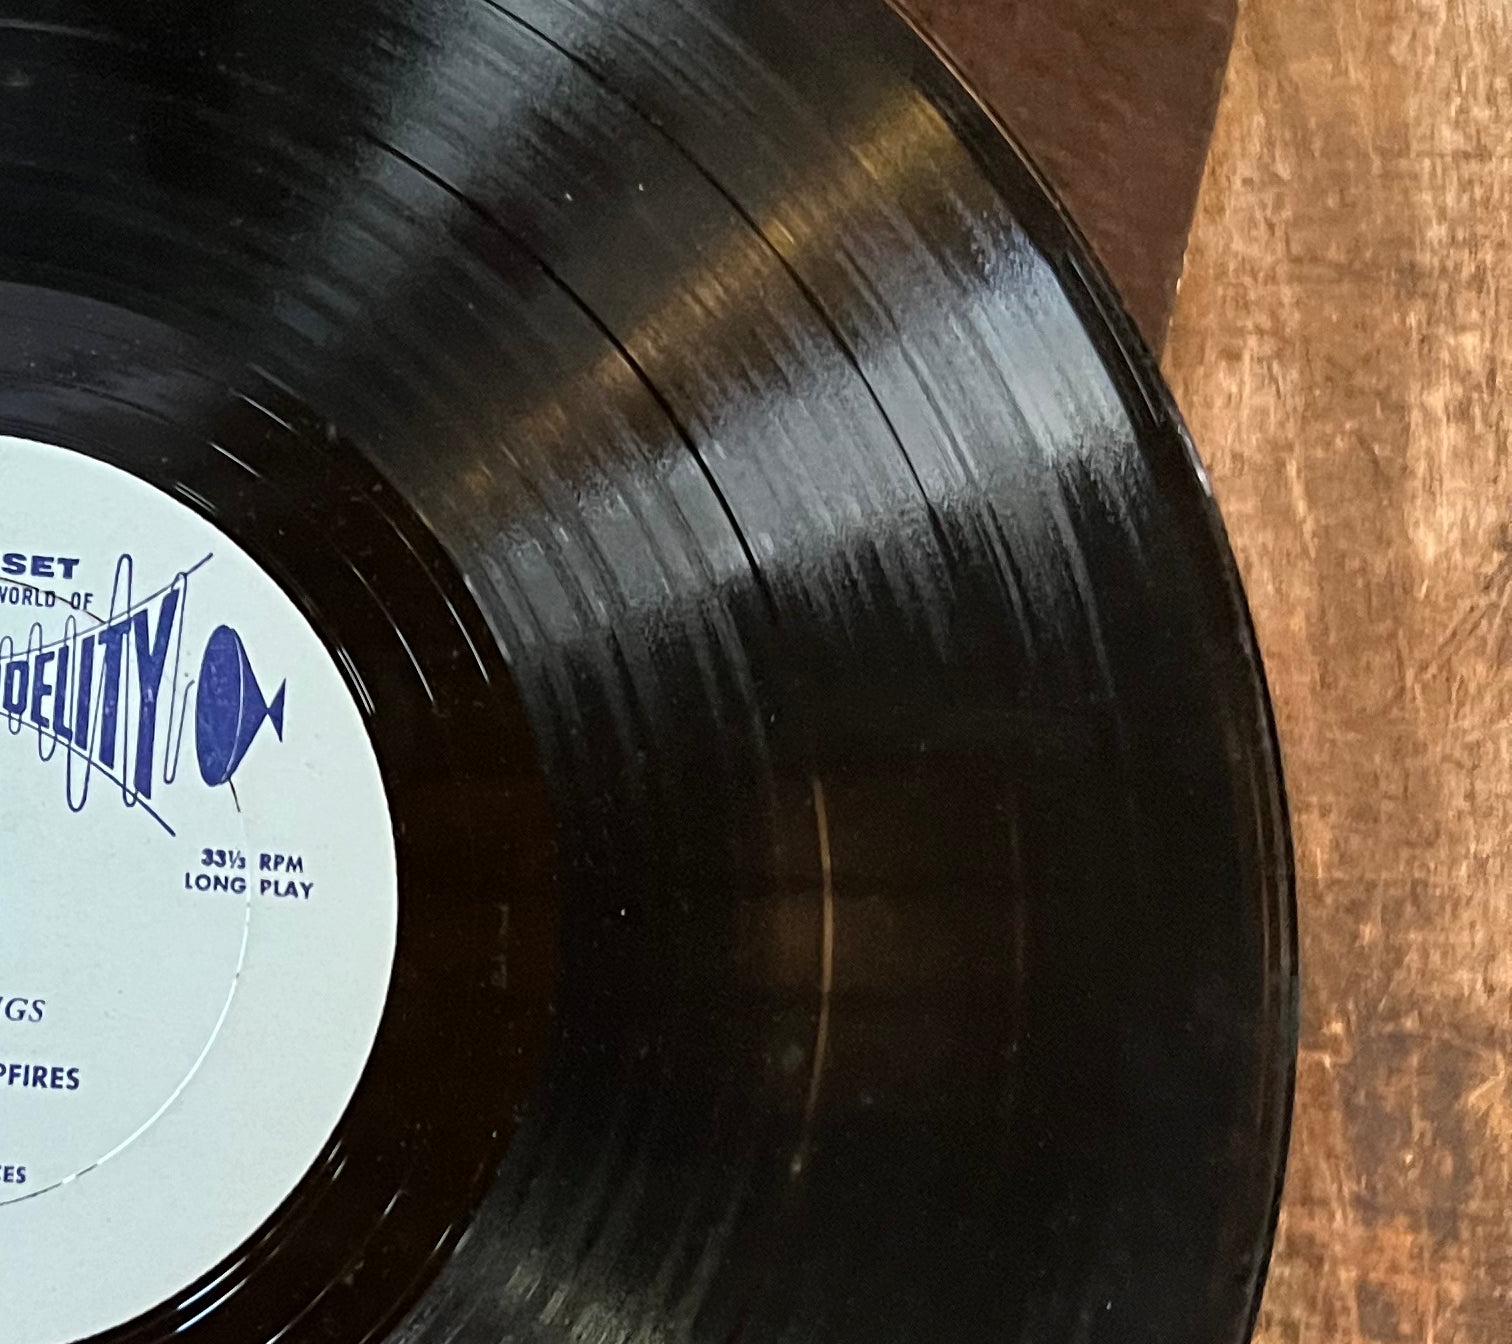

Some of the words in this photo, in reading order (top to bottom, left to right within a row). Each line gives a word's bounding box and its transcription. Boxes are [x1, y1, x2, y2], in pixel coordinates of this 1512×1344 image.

[70, 592, 94, 610] OF
[259, 853, 303, 873] RPM
[185, 872, 246, 894] LONG
[260, 879, 314, 899] PLAY
